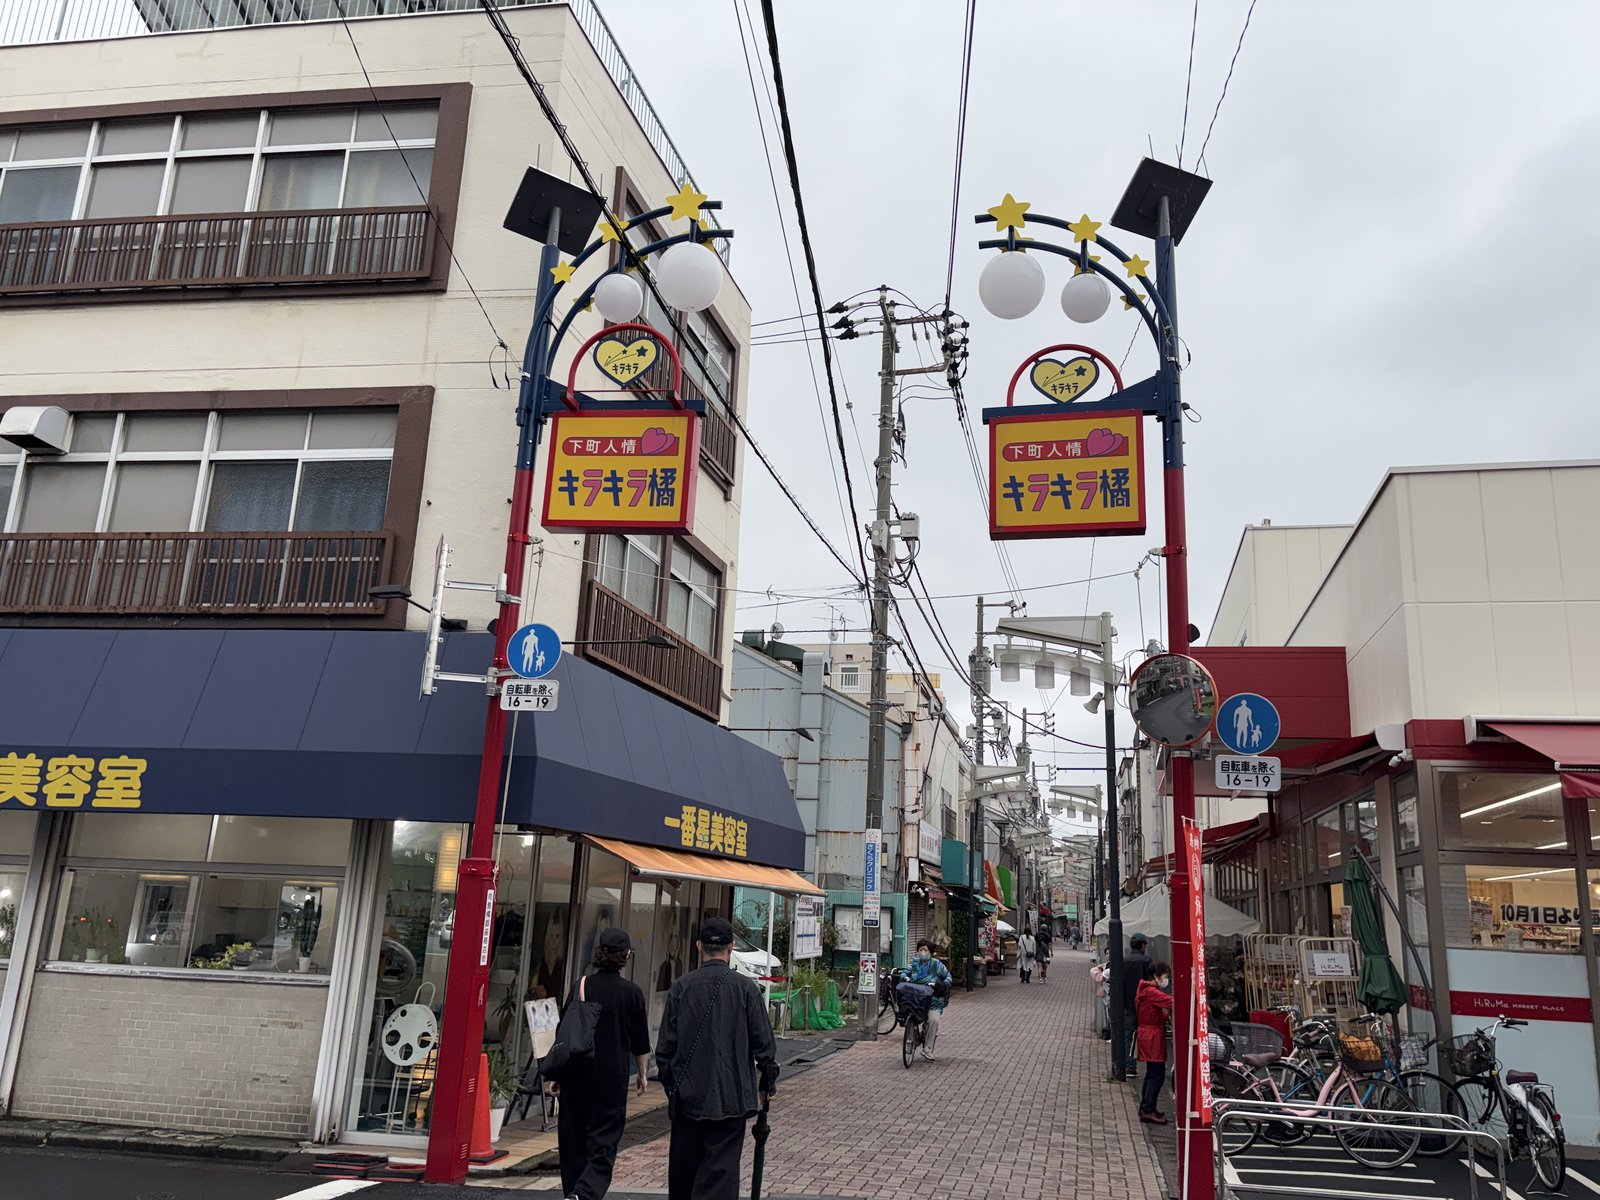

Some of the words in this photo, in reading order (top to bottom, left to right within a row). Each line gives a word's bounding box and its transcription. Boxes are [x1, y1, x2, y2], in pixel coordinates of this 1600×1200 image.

[612, 363, 639, 375] キラキラ
[1051, 382, 1079, 395] キラキラ
[569, 439, 637, 455] 下町人情
[1008, 441, 1082, 459] 下町人情
[558, 468, 677, 507] キラキラ橘
[1002, 467, 1130, 512] キラキラ橘
[506, 684, 553, 695] 自転車を除く
[1221, 760, 1276, 774] 自転車を除く
[664, 805, 748, 857] 一番星美容室
